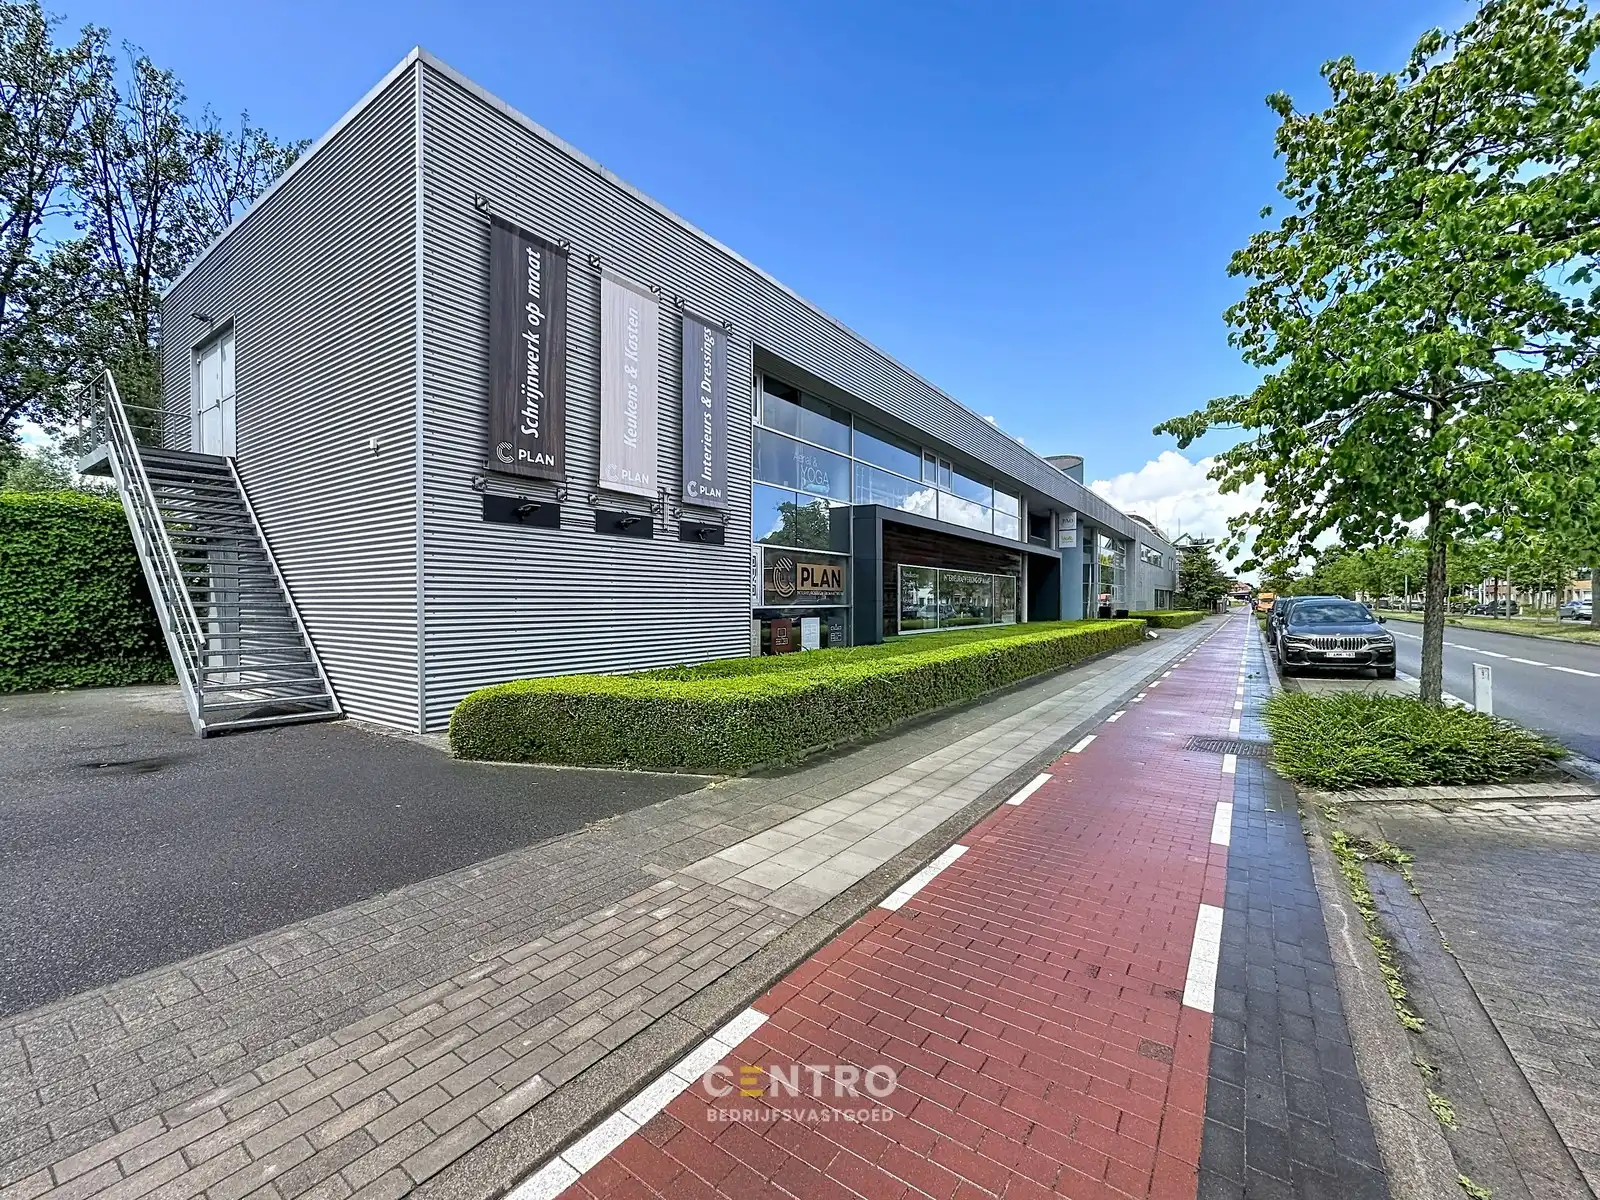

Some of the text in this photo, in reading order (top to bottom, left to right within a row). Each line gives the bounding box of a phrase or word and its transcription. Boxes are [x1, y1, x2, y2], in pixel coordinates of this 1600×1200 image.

[521, 246, 546, 439] Schrijnwerk op maat
[623, 306, 640, 448] Keukens & Kasten
[700, 326, 715, 481] Interieurs & Dressings
[518, 448, 555, 467] PLAN
[621, 469, 649, 485] PLAN
[800, 465, 829, 485] YOGA
[699, 485, 722, 498] PLAN
[800, 566, 841, 589] PLAN
